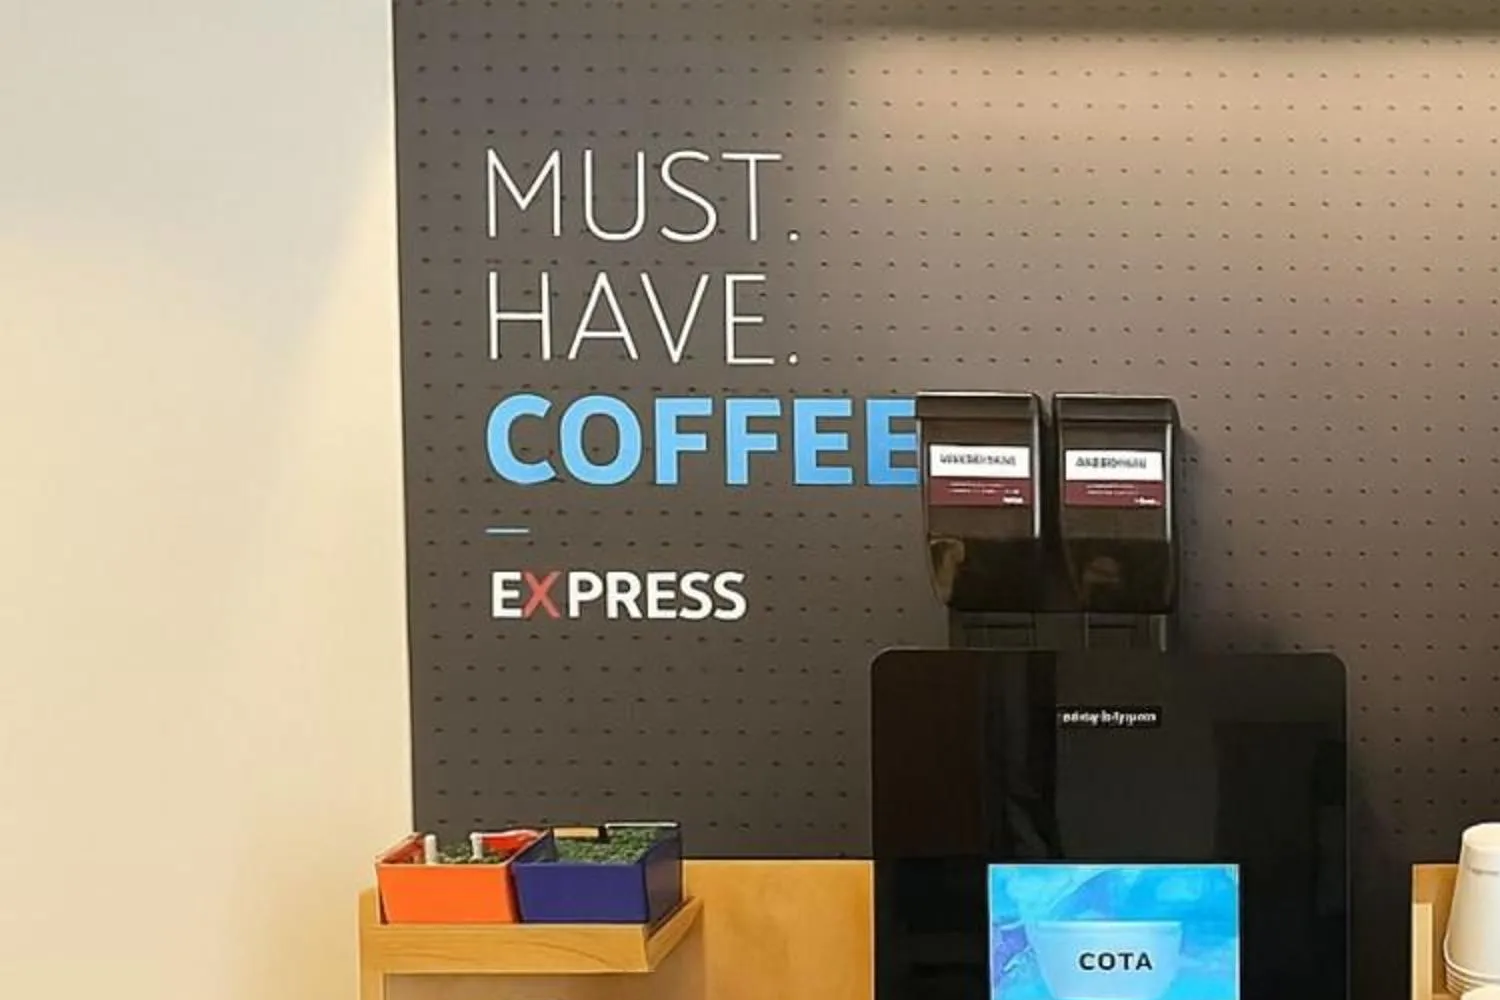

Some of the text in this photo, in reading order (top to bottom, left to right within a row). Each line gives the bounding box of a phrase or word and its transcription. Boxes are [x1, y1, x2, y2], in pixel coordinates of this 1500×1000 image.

[486, 148, 800, 242] MUST.
[488, 271, 799, 365] HAVE.
[485, 393, 919, 486] COFFEE
[490, 570, 748, 621] EXPRESS
[1078, 951, 1153, 972] COTA
